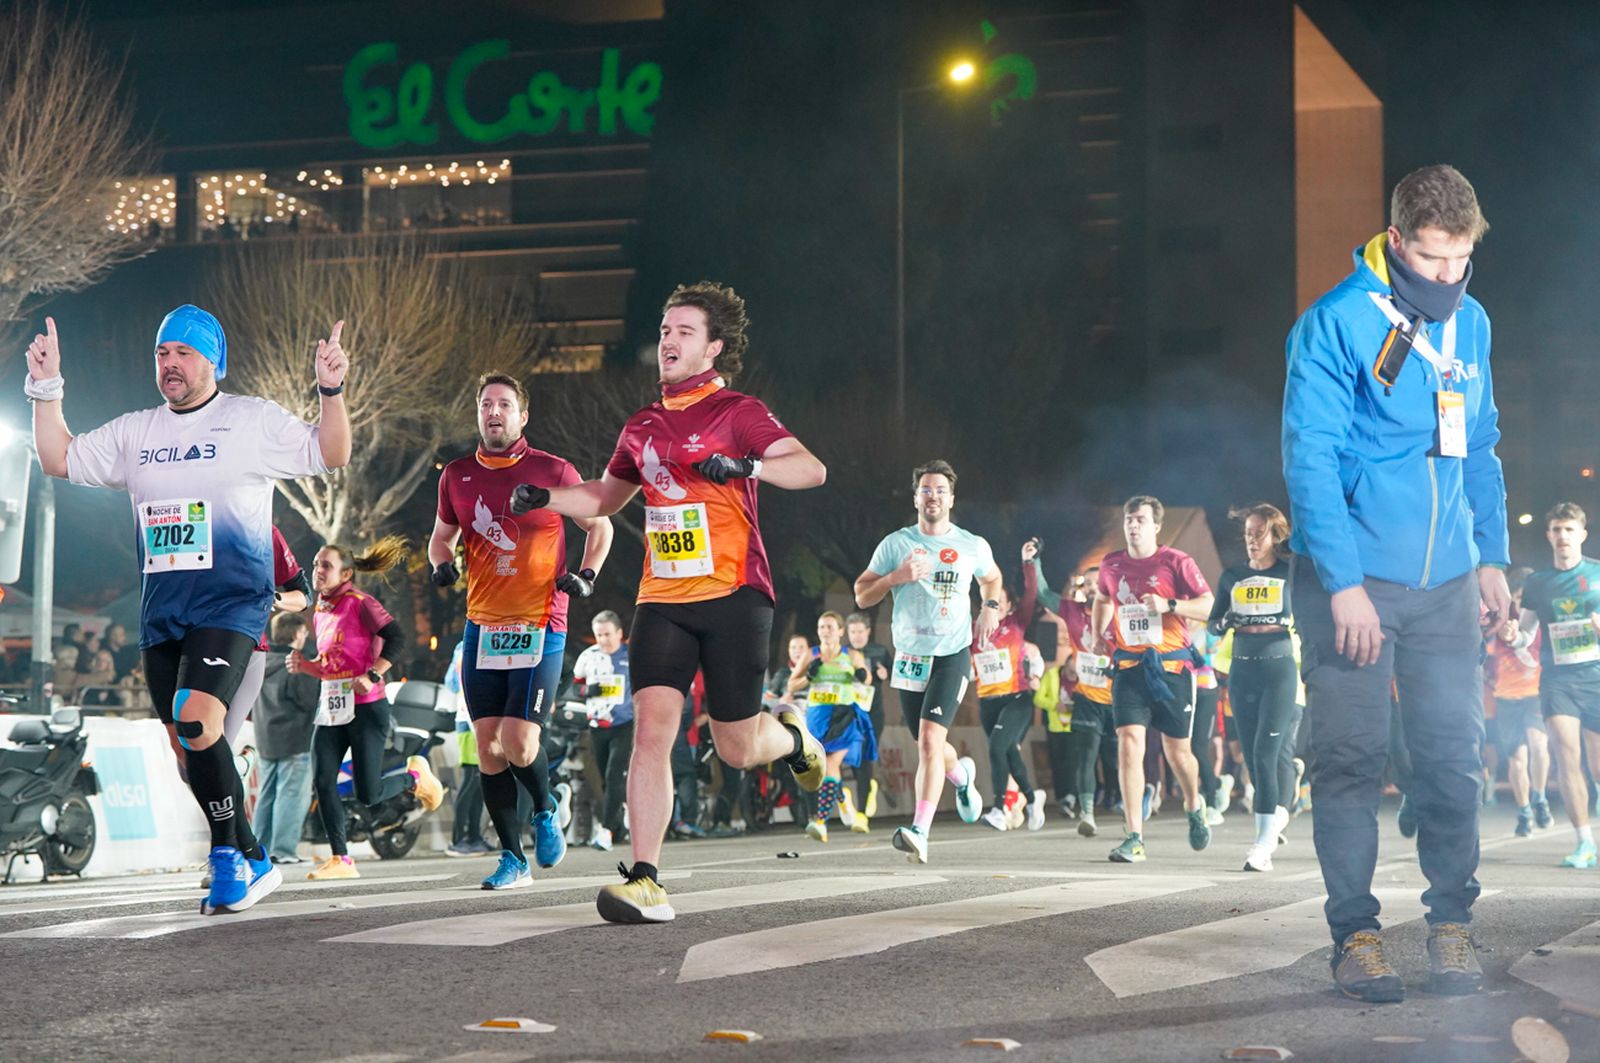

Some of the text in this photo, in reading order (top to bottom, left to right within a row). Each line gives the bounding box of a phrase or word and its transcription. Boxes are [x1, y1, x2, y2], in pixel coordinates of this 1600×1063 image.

[343, 39, 663, 147] El Corte
[655, 471, 671, 491] 43
[173, 506, 182, 514] DE
[153, 524, 195, 548] 2702
[486, 526, 501, 542] 43
[1246, 587, 1268, 599] 874
[1129, 618, 1149, 631] 618
[1250, 616, 1277, 624] PRO
[491, 633, 532, 650] 6229
[899, 661, 923, 676] 275
[328, 696, 346, 709] 631
[104, 782, 147, 807] alsa
